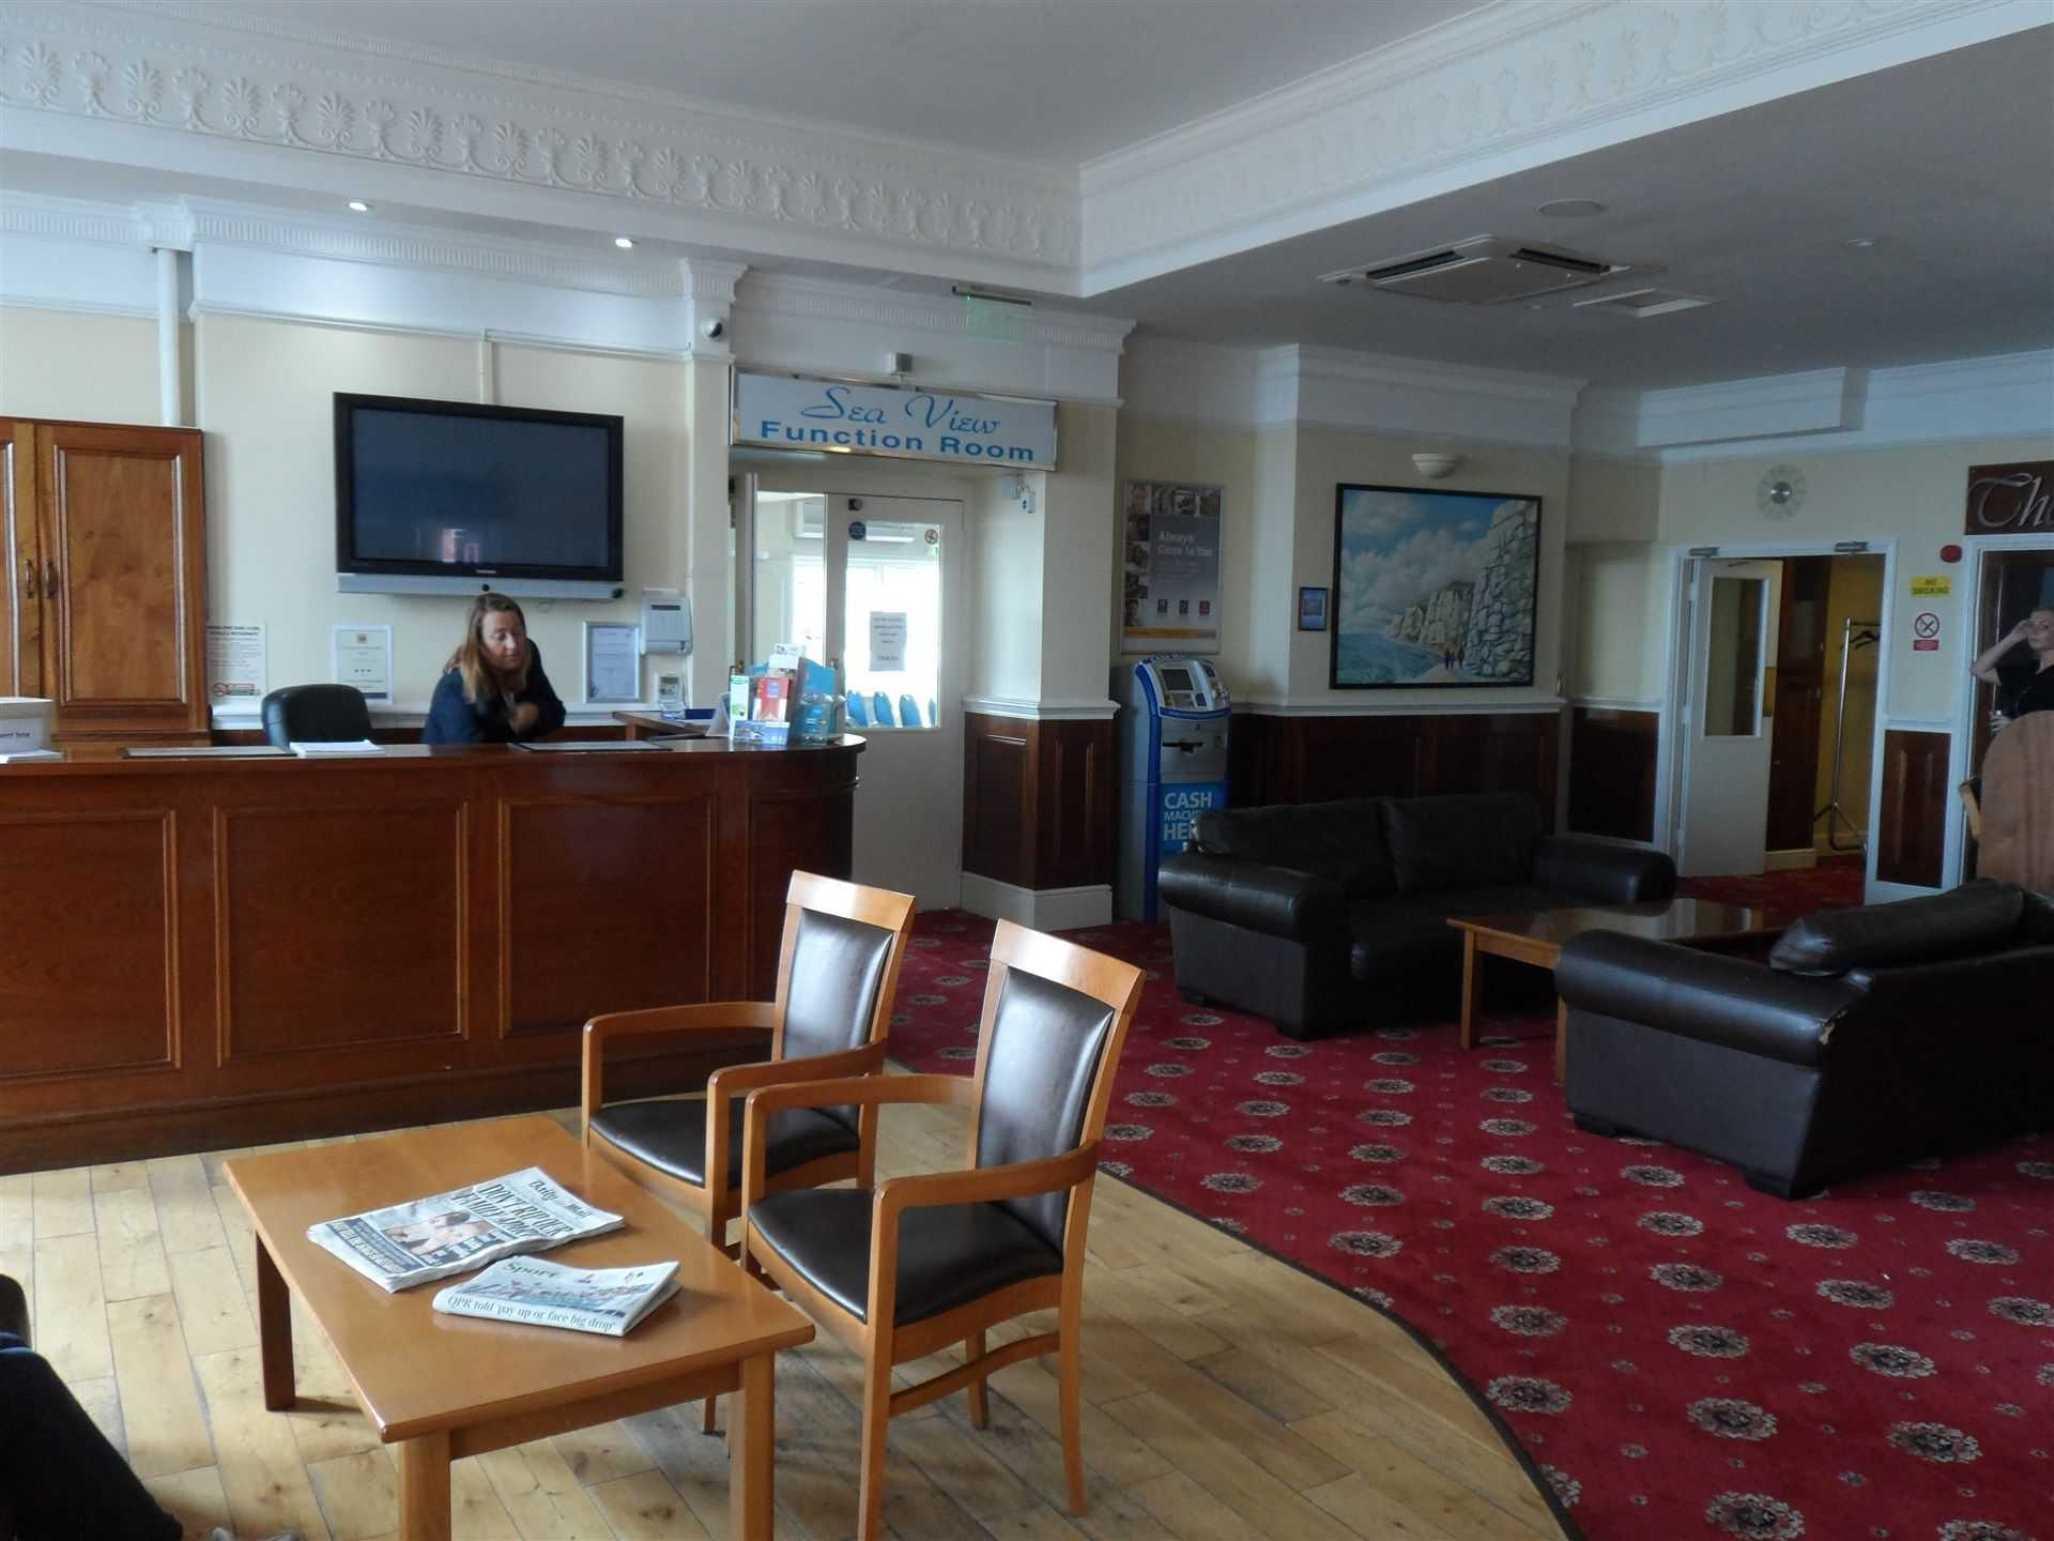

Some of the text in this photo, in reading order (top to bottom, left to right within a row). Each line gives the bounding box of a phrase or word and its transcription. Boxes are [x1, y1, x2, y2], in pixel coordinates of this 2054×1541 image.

[801, 387, 1000, 434] Sea View
[761, 421, 1034, 461] Function Room
[1164, 792, 1212, 809] CASH
[518, 1308, 531, 1319] up
[532, 1311, 546, 1319] or
[547, 1310, 570, 1322] face
[570, 1314, 587, 1327] big
